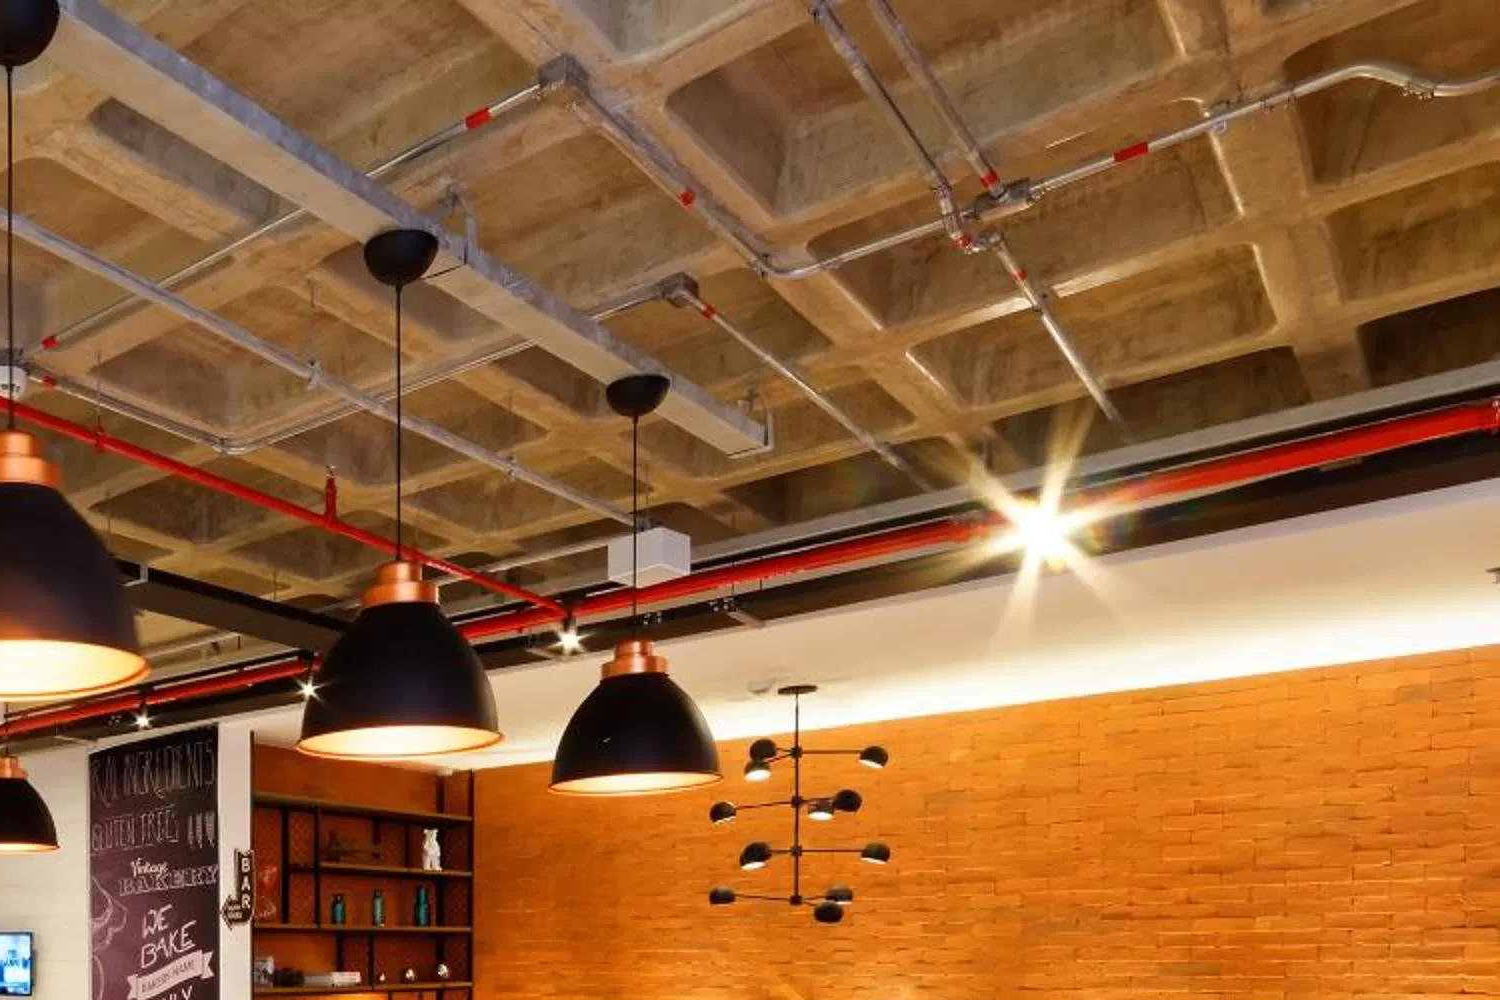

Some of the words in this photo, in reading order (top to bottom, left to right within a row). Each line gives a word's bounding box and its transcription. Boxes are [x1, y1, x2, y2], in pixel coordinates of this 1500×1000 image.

[119, 863, 219, 897] BAKERY
[240, 856, 251, 909] BAR
[140, 920, 197, 969] BAKE
